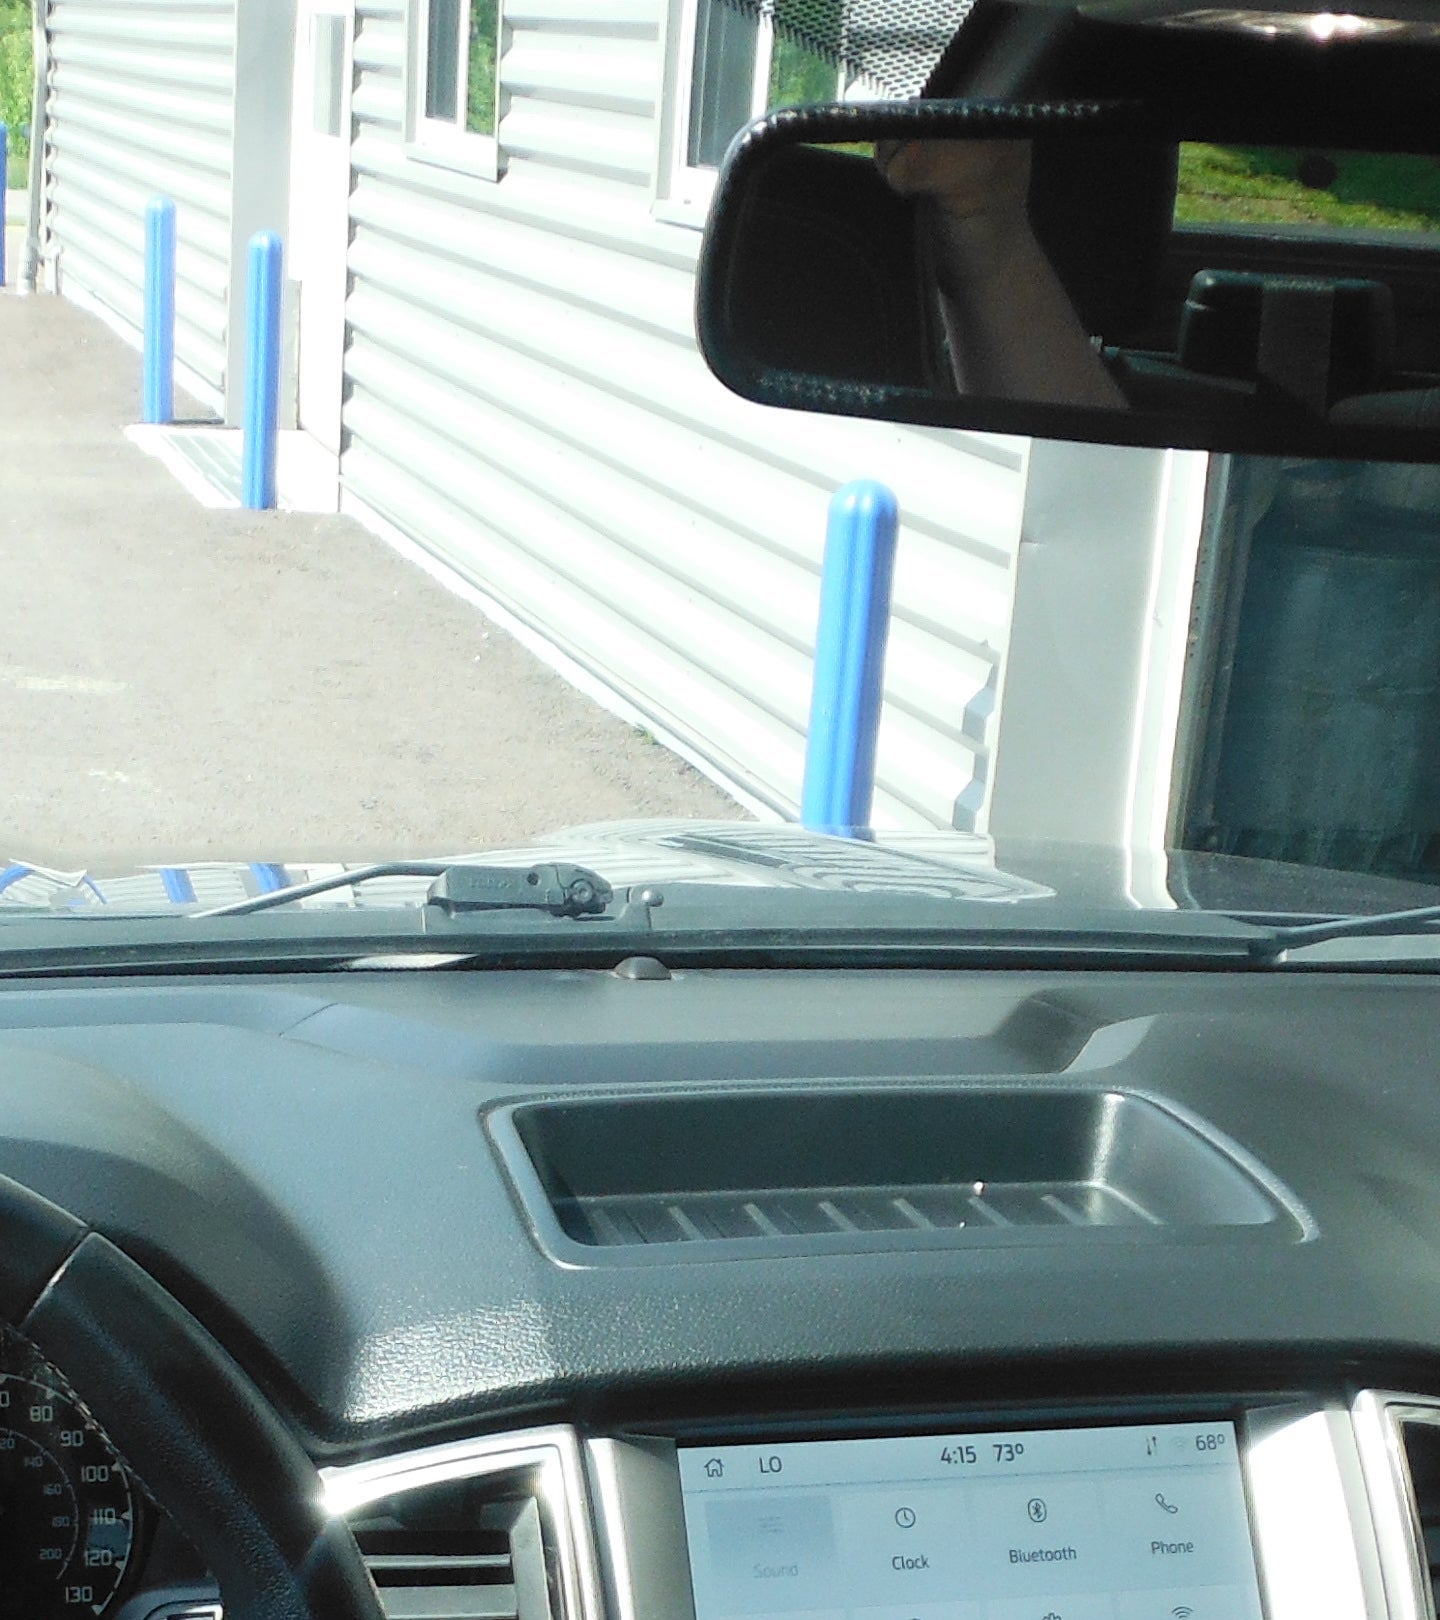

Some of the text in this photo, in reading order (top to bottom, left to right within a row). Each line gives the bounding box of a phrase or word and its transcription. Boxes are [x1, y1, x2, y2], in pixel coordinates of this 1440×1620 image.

[29, 1406, 53, 1422] 80
[60, 1430, 83, 1446] 90
[940, 1446, 977, 1464] 4:15
[759, 1455, 783, 1473] LO
[81, 1465, 109, 1482] 100
[92, 1508, 116, 1524] 110
[1009, 1547, 1077, 1563] Bluetooth
[1151, 1541, 1194, 1555] Phone
[84, 1550, 111, 1566] 120
[892, 1554, 930, 1571] Clock
[753, 1563, 799, 1578] Sound
[65, 1586, 93, 1602] 130
